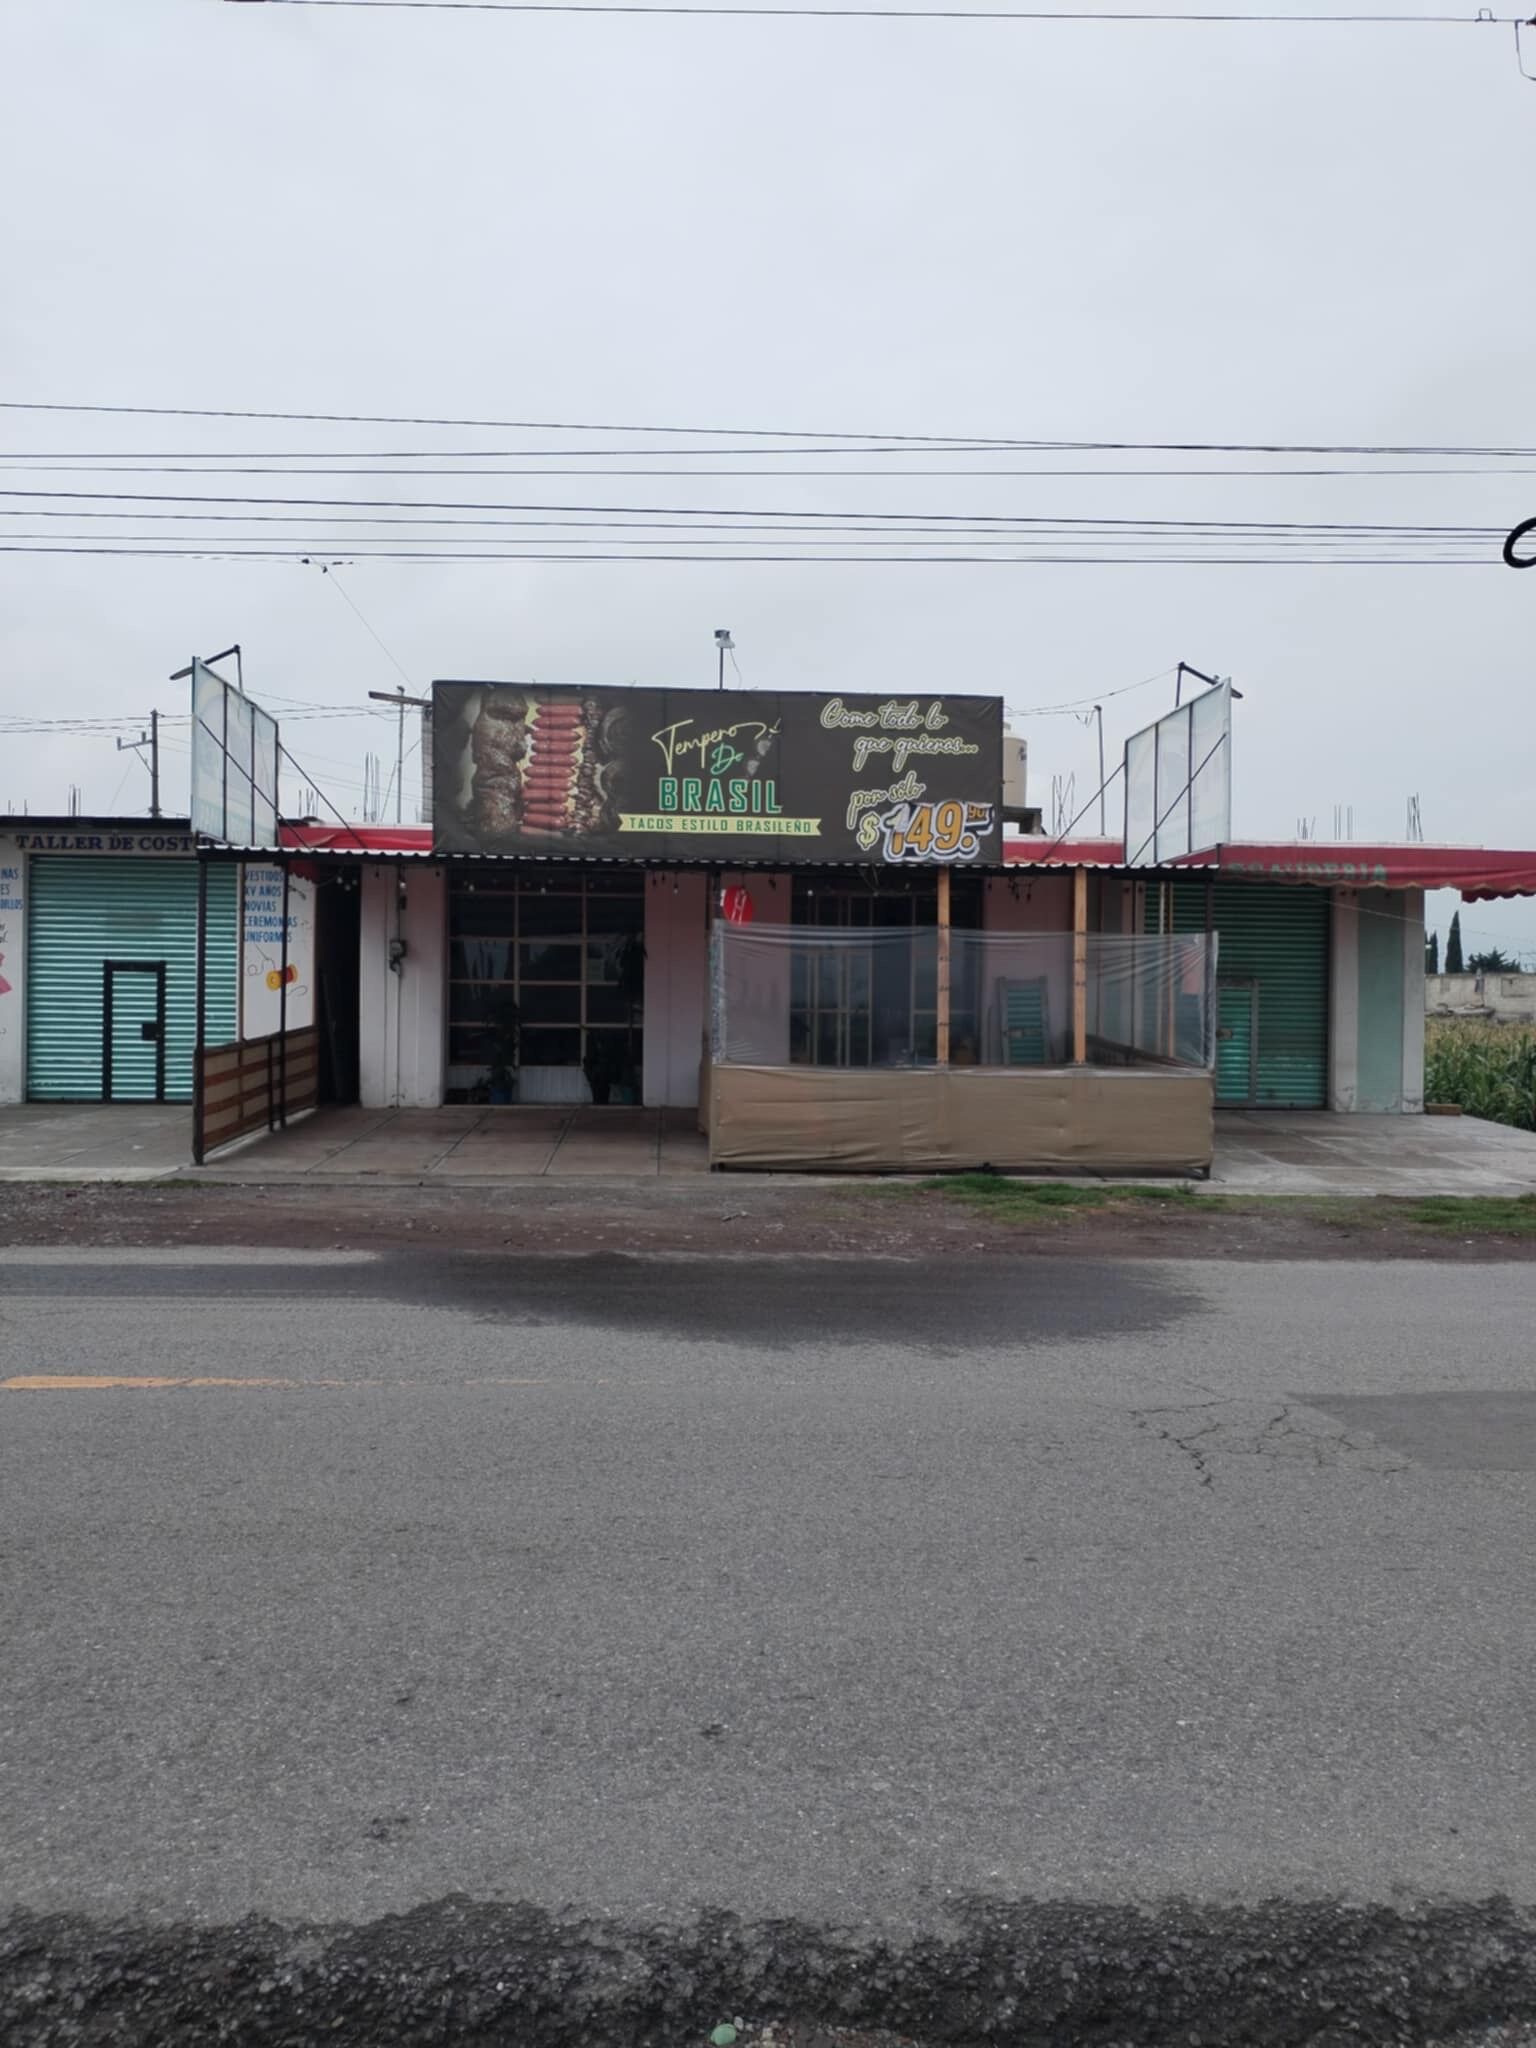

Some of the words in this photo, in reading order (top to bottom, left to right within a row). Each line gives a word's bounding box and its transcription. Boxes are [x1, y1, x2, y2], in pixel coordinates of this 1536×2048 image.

[820, 698, 879, 728] Come
[878, 700, 924, 729] todo
[925, 701, 949, 730] lo
[651, 718, 767, 776] Tempero
[710, 742, 744, 775] De
[852, 736, 893, 772] que
[658, 777, 783, 814] BRASIL
[847, 790, 887, 829] por
[15, 834, 102, 850] TALLER
[108, 834, 135, 850] DE
[628, 816, 674, 831] TACOS
[681, 817, 729, 832] ESTILO
[735, 818, 812, 834] BRASILEÑO
